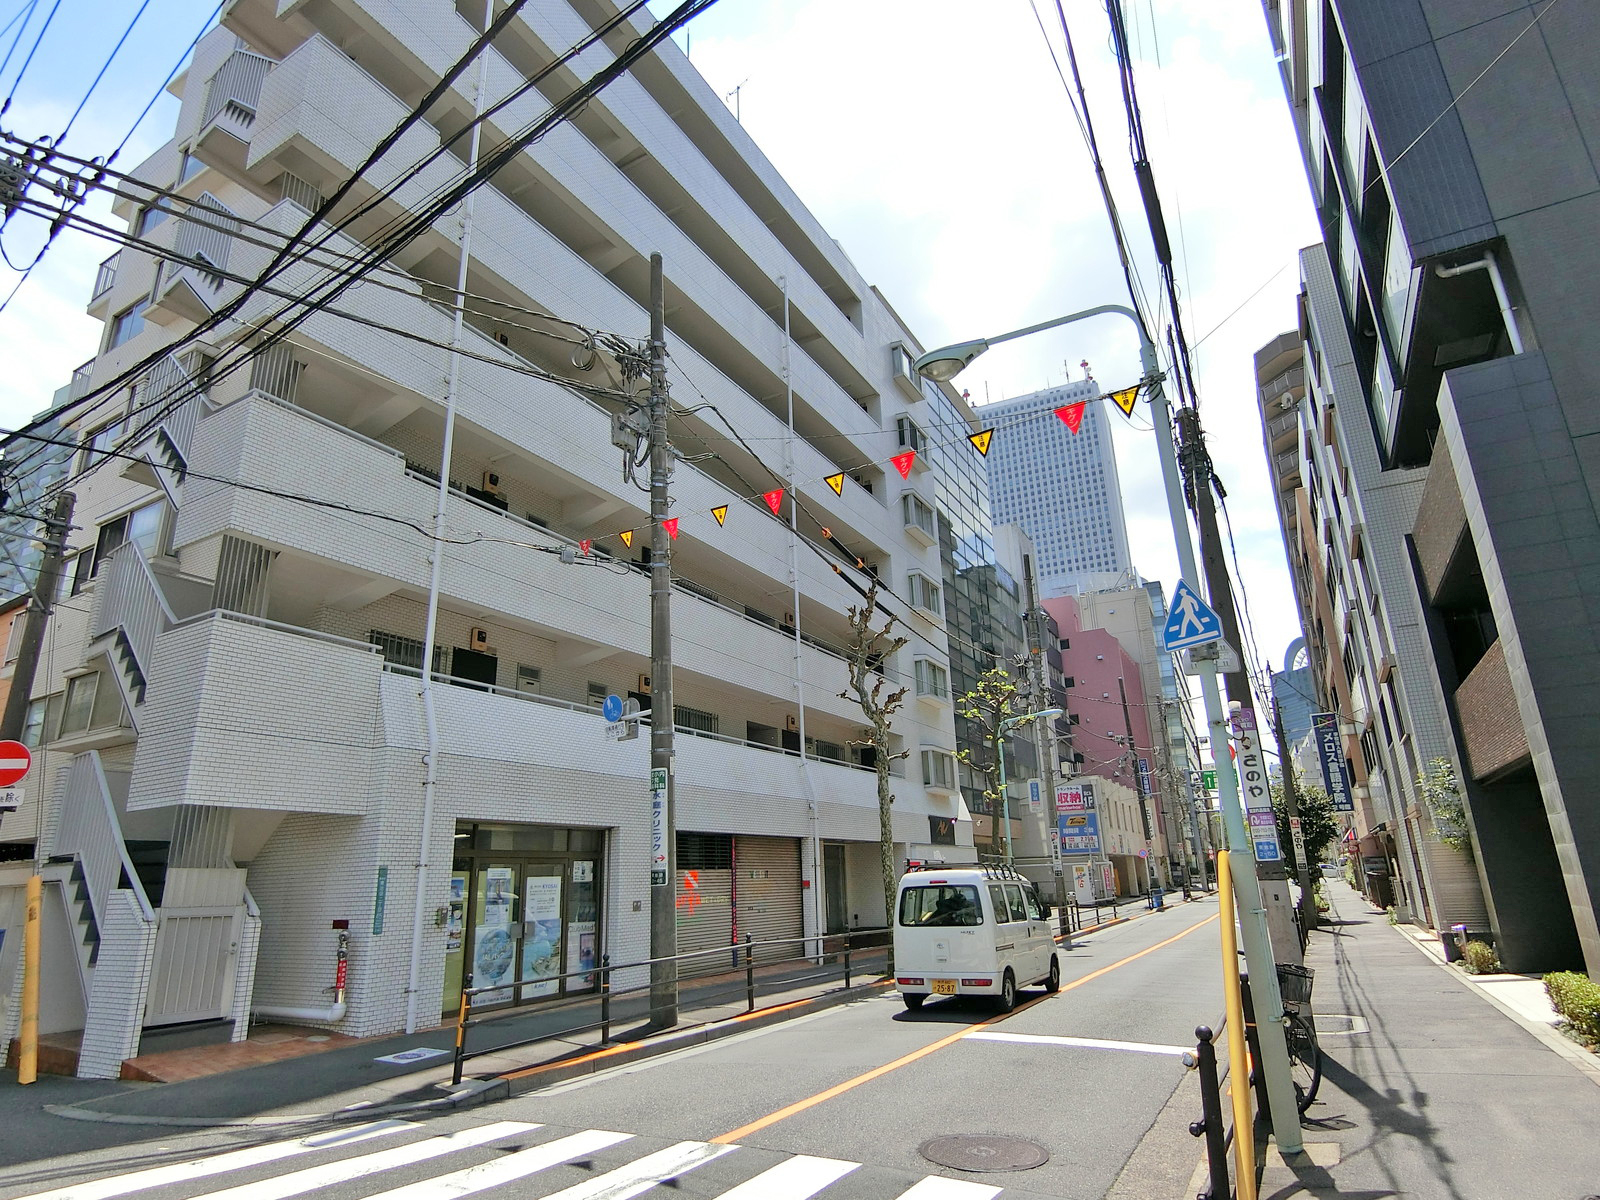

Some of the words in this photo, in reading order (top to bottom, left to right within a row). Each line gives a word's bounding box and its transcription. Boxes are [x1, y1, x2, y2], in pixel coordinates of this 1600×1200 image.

[978, 434, 986, 448] 注意
[1243, 753, 1264, 798] さのや
[1323, 732, 1347, 803] メロス言語学院
[1057, 791, 1082, 804] 収納
[1084, 796, 1094, 807] 1F
[652, 791, 662, 852] 水庭クリニック
